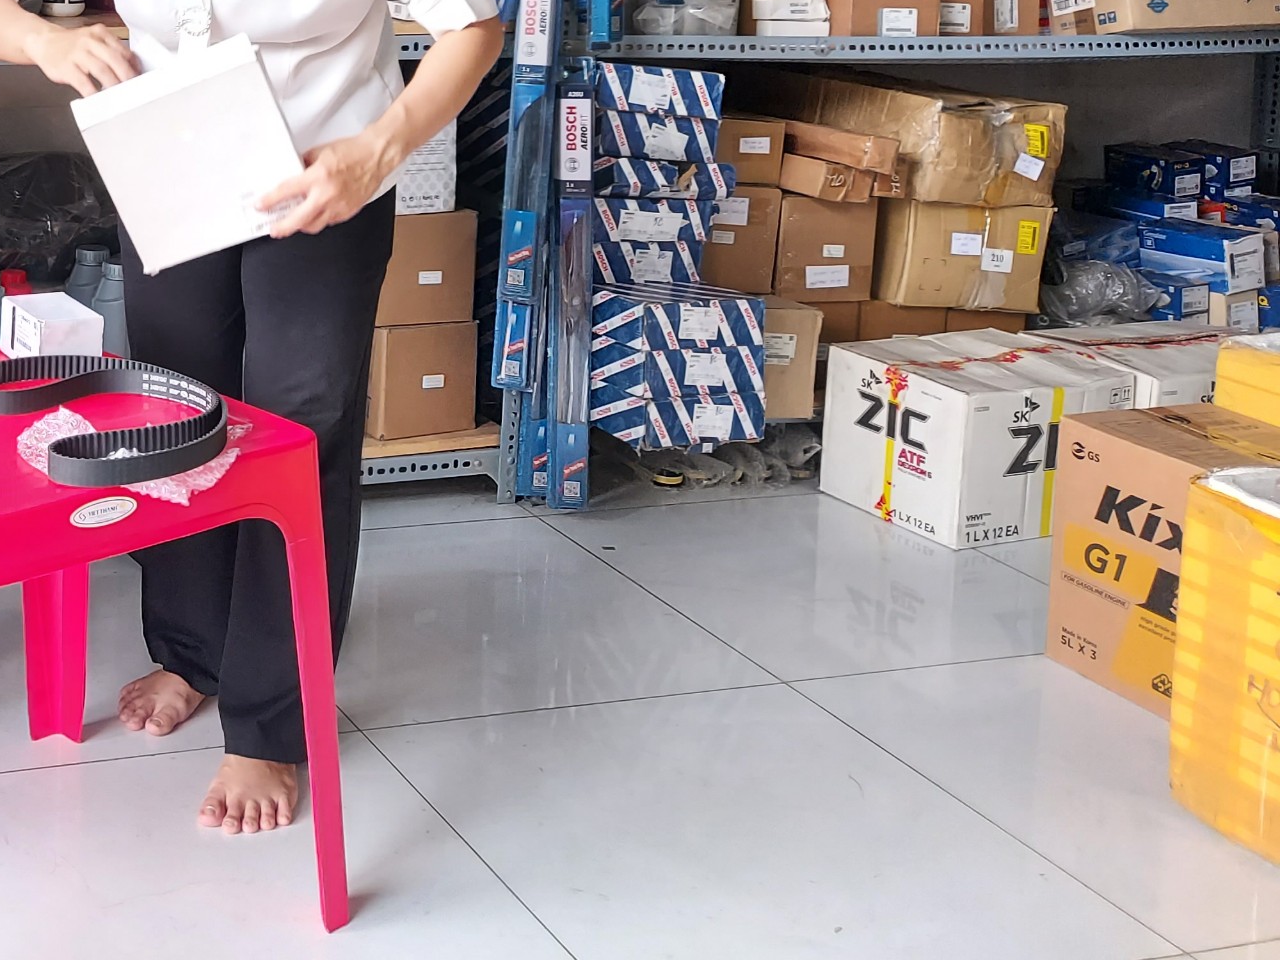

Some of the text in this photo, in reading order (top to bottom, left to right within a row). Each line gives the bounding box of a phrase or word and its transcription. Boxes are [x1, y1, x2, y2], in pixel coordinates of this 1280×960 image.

[539, 0, 549, 36] AEROFIT
[698, 84, 711, 107] BOSCH
[566, 105, 577, 152] BOSCH
[580, 113, 590, 151] AEROFIT
[615, 123, 627, 147] BOSCH
[712, 166, 725, 191] BOSCH
[602, 209, 615, 233] BOSCH
[595, 250, 609, 273] BOSCH
[990, 253, 1005, 263] 210
[743, 307, 757, 330] BOSCH
[745, 353, 757, 376] BOSCH
[861, 377, 873, 390] SK
[654, 417, 667, 439] BOSCH
[853, 388, 932, 455] ZIC
[1013, 410, 1030, 424] SK
[898, 447, 927, 466] ATF
[1002, 421, 1060, 478] ZI
[1087, 450, 1100, 463] GS
[913, 517, 924, 530] 12
[924, 520, 937, 536] EA
[1094, 484, 1184, 555] Kix
[982, 528, 990, 541] X
[992, 526, 1003, 539] 12
[1005, 524, 1019, 537] EA
[1084, 542, 1128, 582] G1
[1104, 592, 1127, 607] ENGINE
[1060, 634, 1097, 661] 5L X 3
